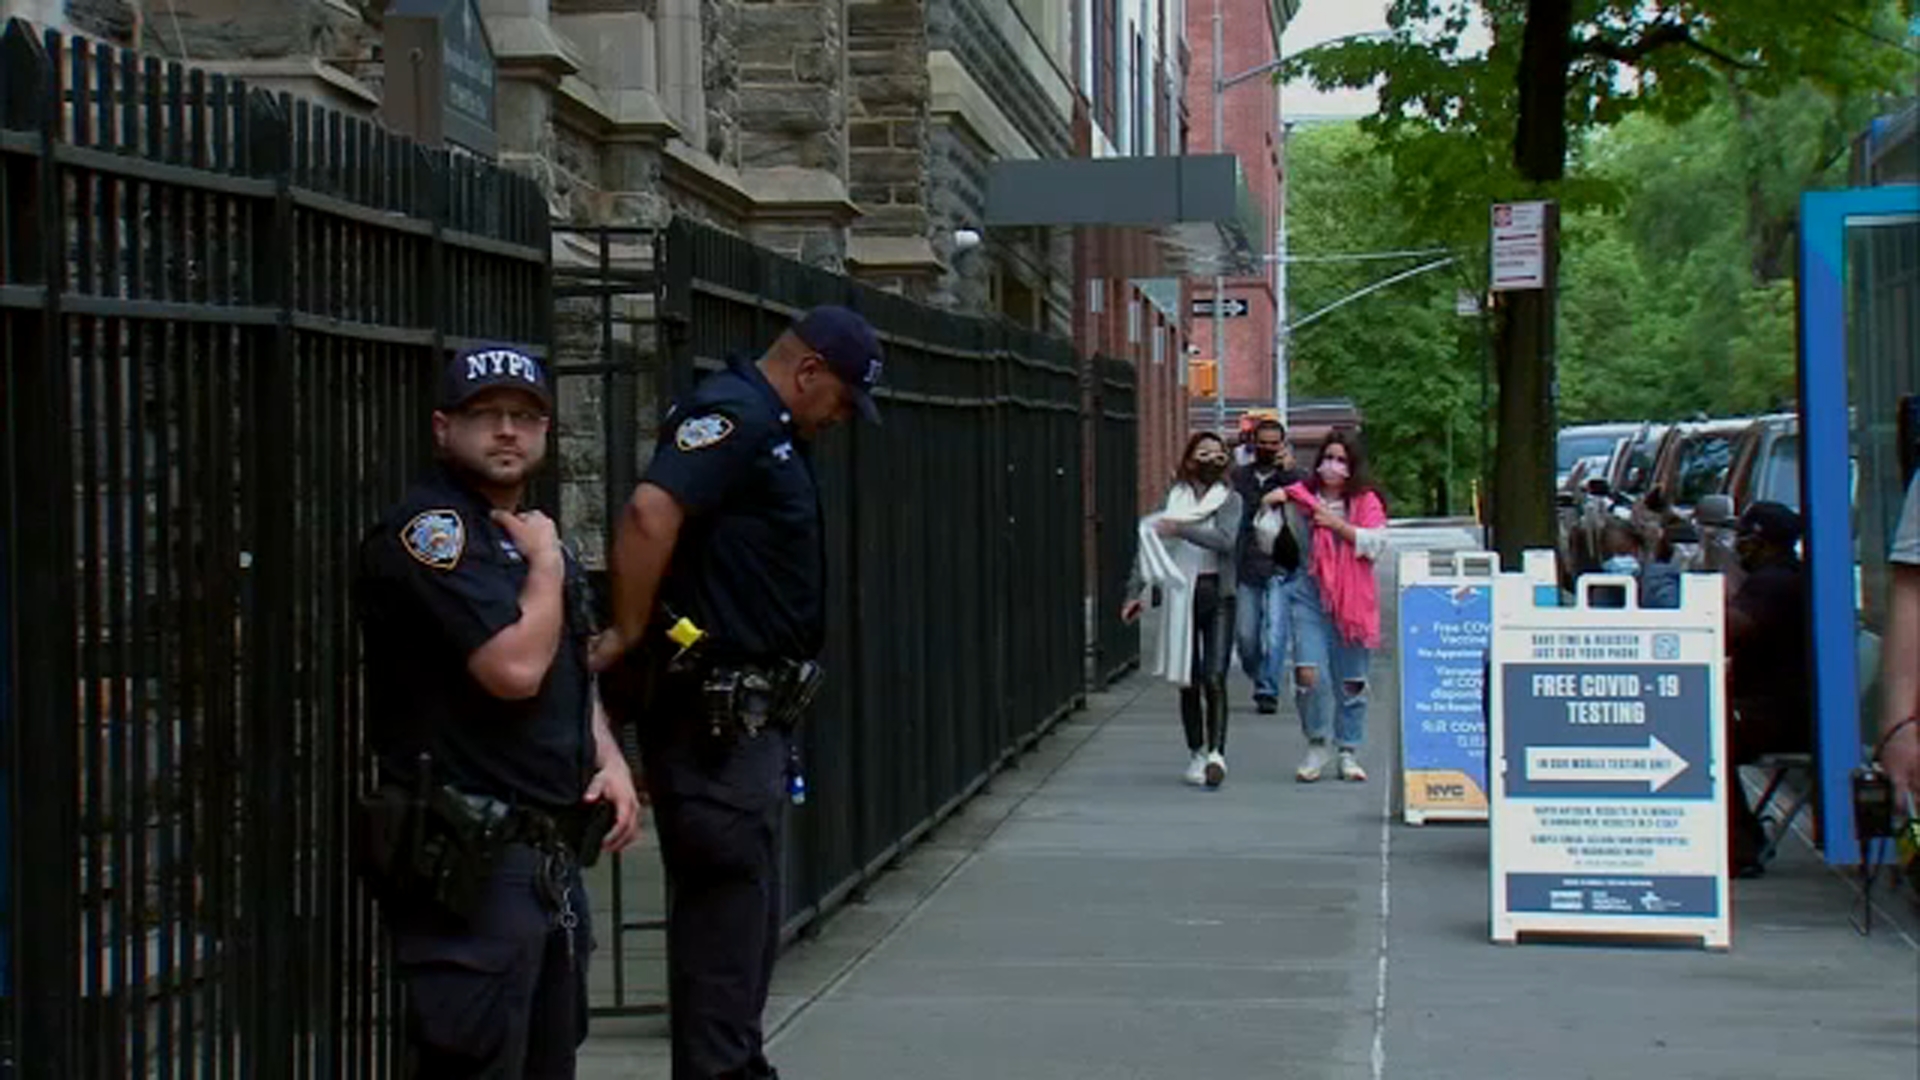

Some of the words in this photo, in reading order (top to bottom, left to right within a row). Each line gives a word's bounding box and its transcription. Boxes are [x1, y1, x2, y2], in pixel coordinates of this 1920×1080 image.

[466, 350, 536, 383] NYPD
[1532, 673, 1577, 697] FREE
[1580, 673, 1640, 697] COVID
[1656, 673, 1680, 697] 19
[1566, 701, 1646, 725] TESTING
[1426, 785, 1465, 796] NYC
